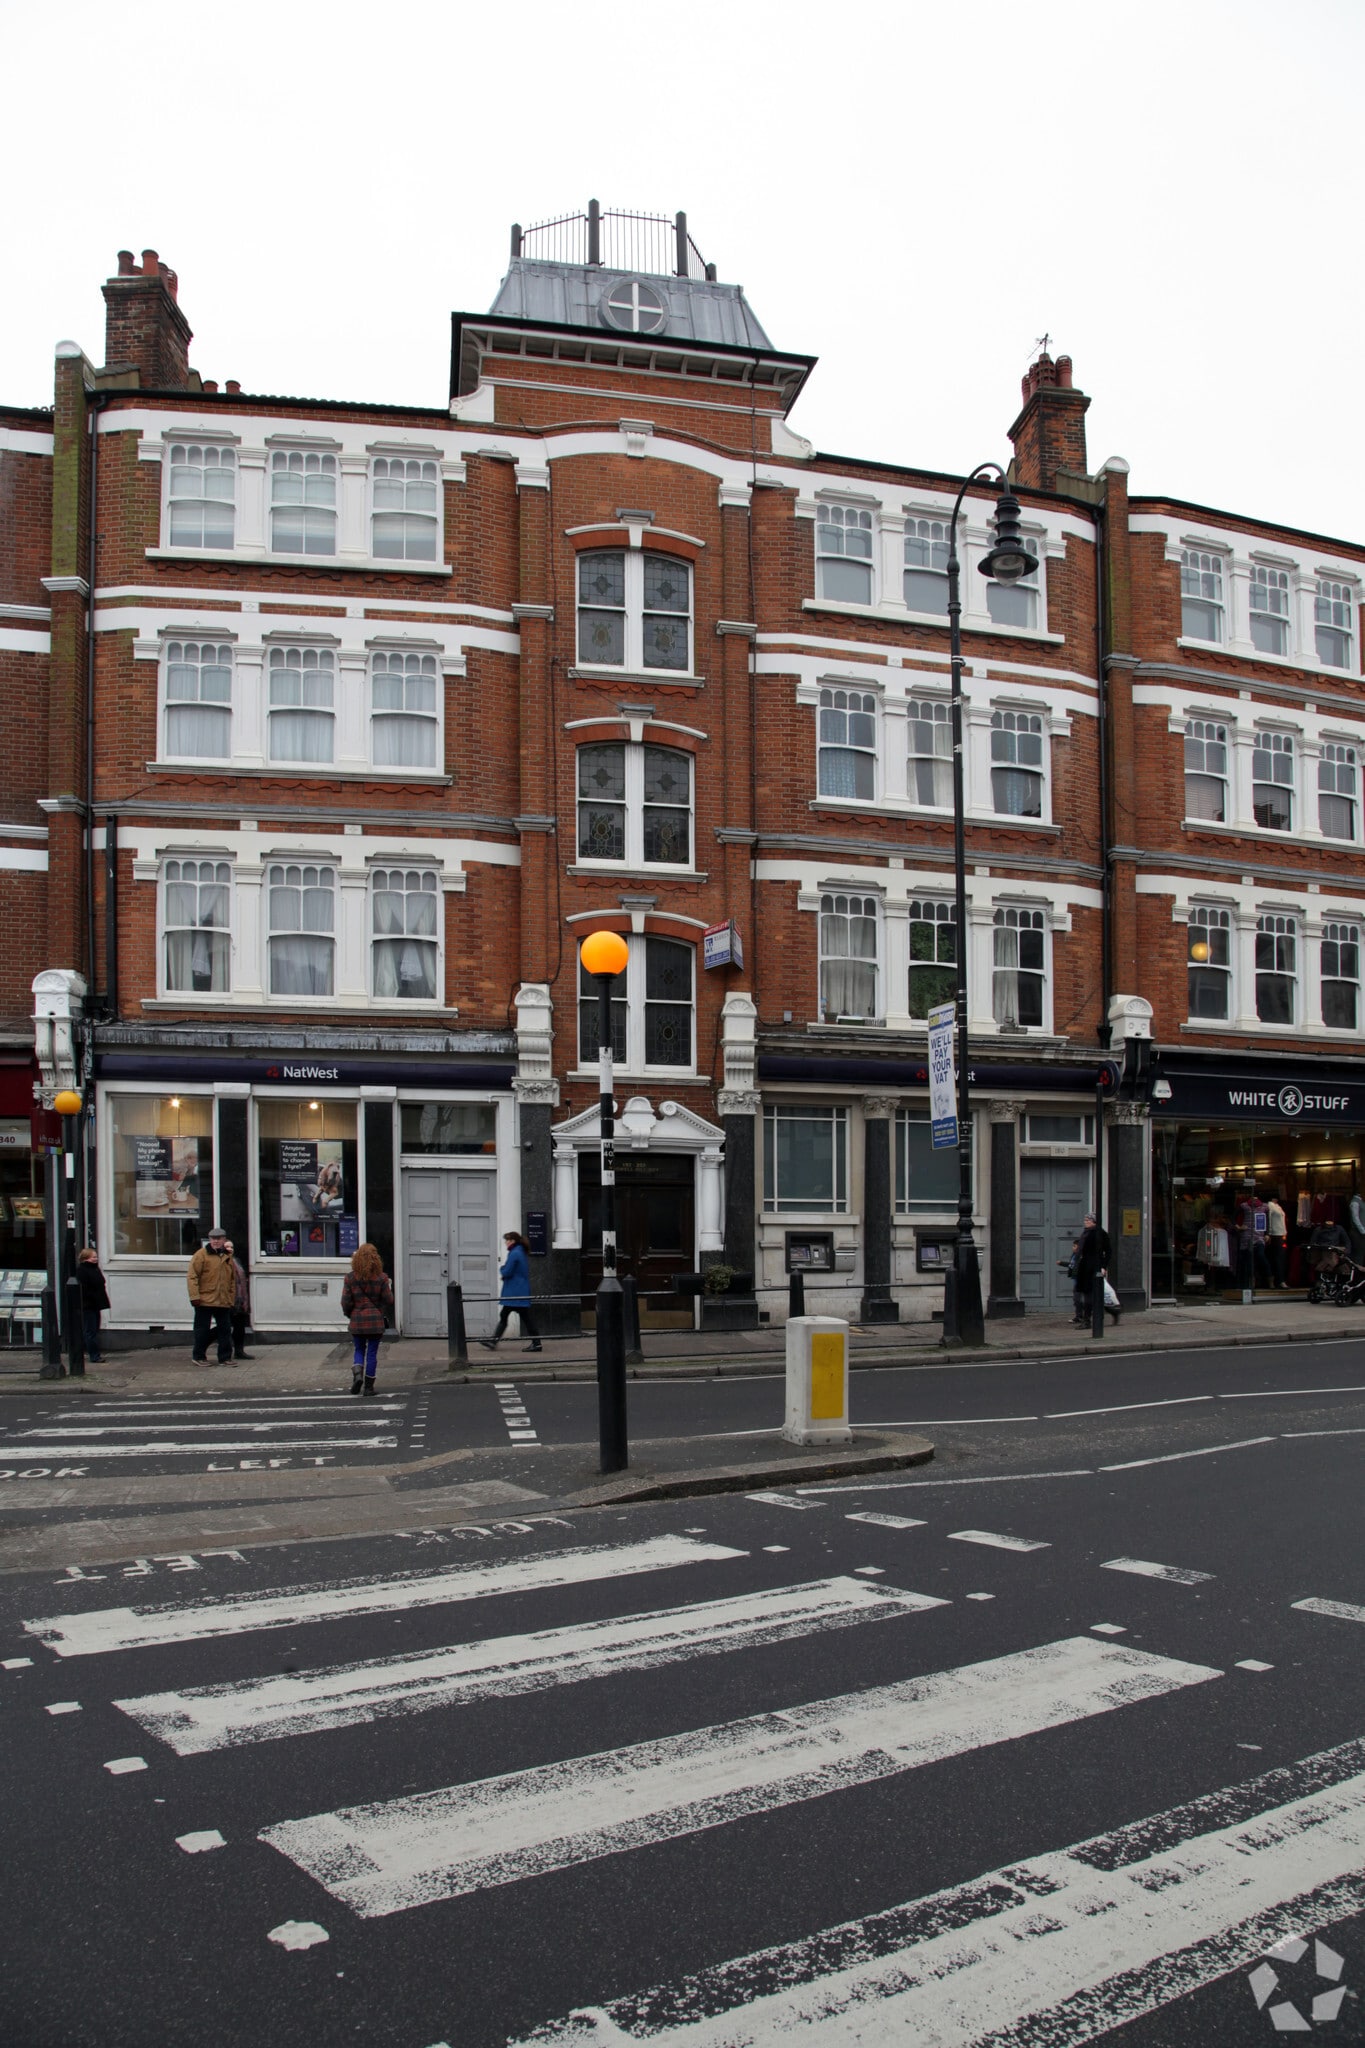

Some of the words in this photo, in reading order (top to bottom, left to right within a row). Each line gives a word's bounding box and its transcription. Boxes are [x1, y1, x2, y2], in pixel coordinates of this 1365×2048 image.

[930, 1033, 951, 1050] WE'LL
[934, 1047, 948, 1060] PAY
[283, 1066, 339, 1079] NatWest
[931, 1058, 951, 1073] YOUR
[934, 1071, 948, 1085] VAT
[1228, 1091, 1276, 1107] WHITE
[1303, 1095, 1350, 1110] STUFF
[206, 1456, 335, 1471] LEFT
[53, 1550, 249, 1586] LEFT
